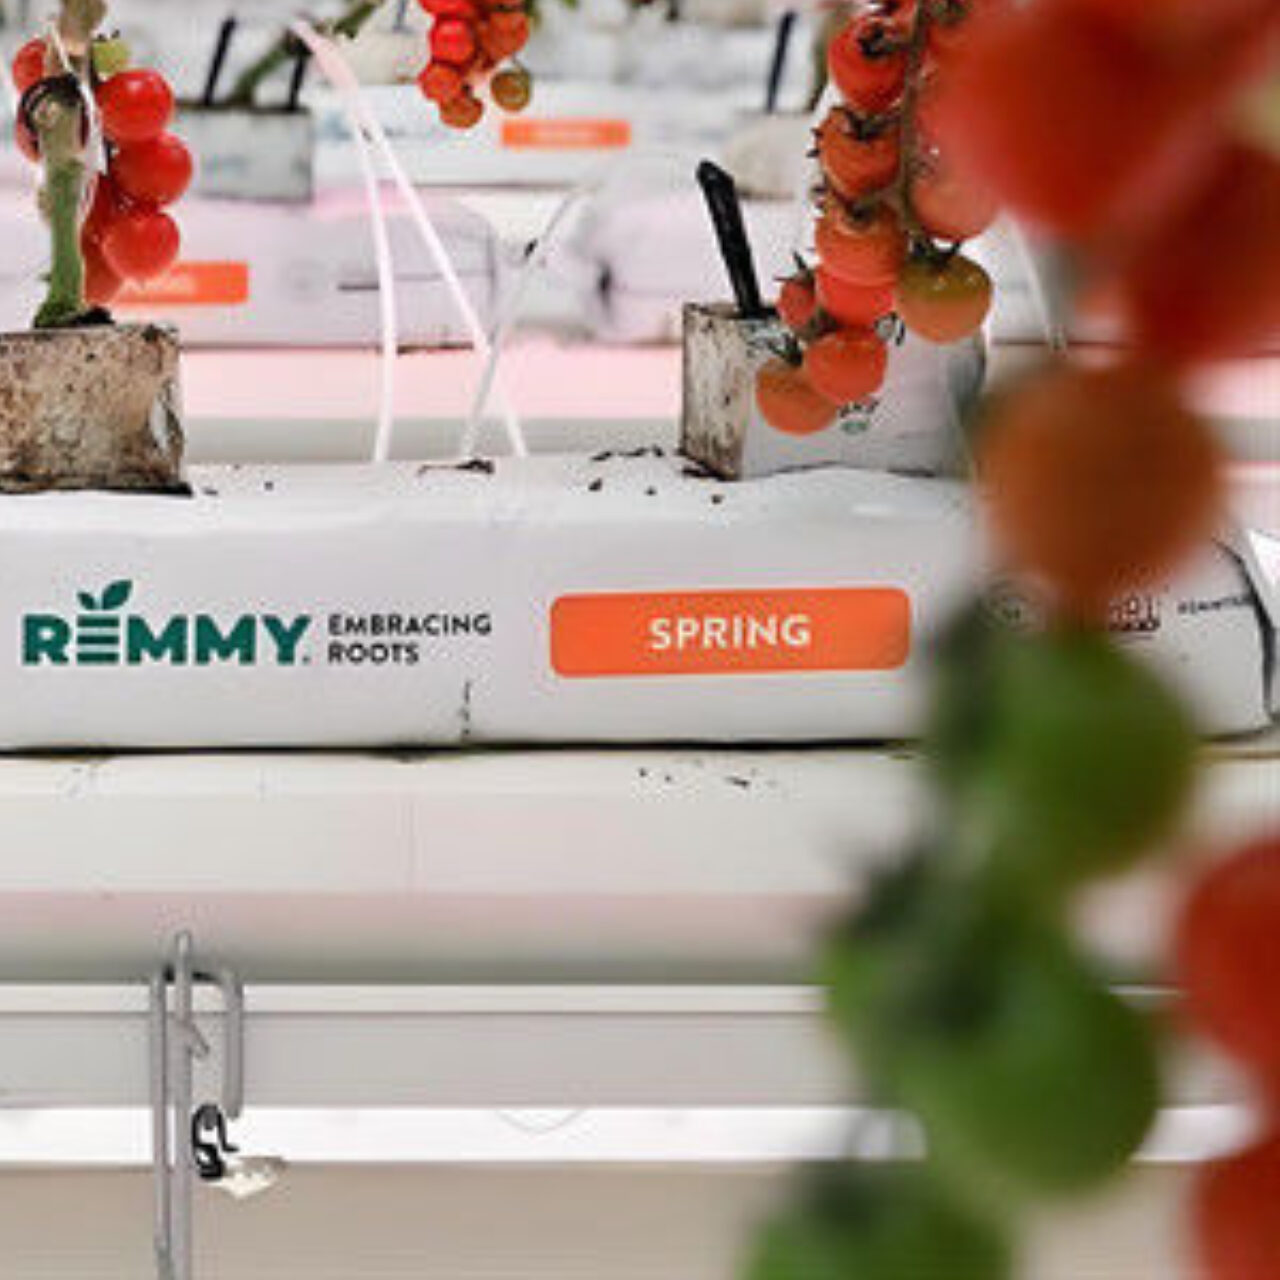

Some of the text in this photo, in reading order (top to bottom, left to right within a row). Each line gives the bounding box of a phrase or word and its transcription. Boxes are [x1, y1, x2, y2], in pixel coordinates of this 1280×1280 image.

[21, 612, 311, 665] REMMY
[327, 613, 492, 636] EMBRACING
[648, 613, 811, 651] SPRING
[327, 642, 420, 664] ROOTS
